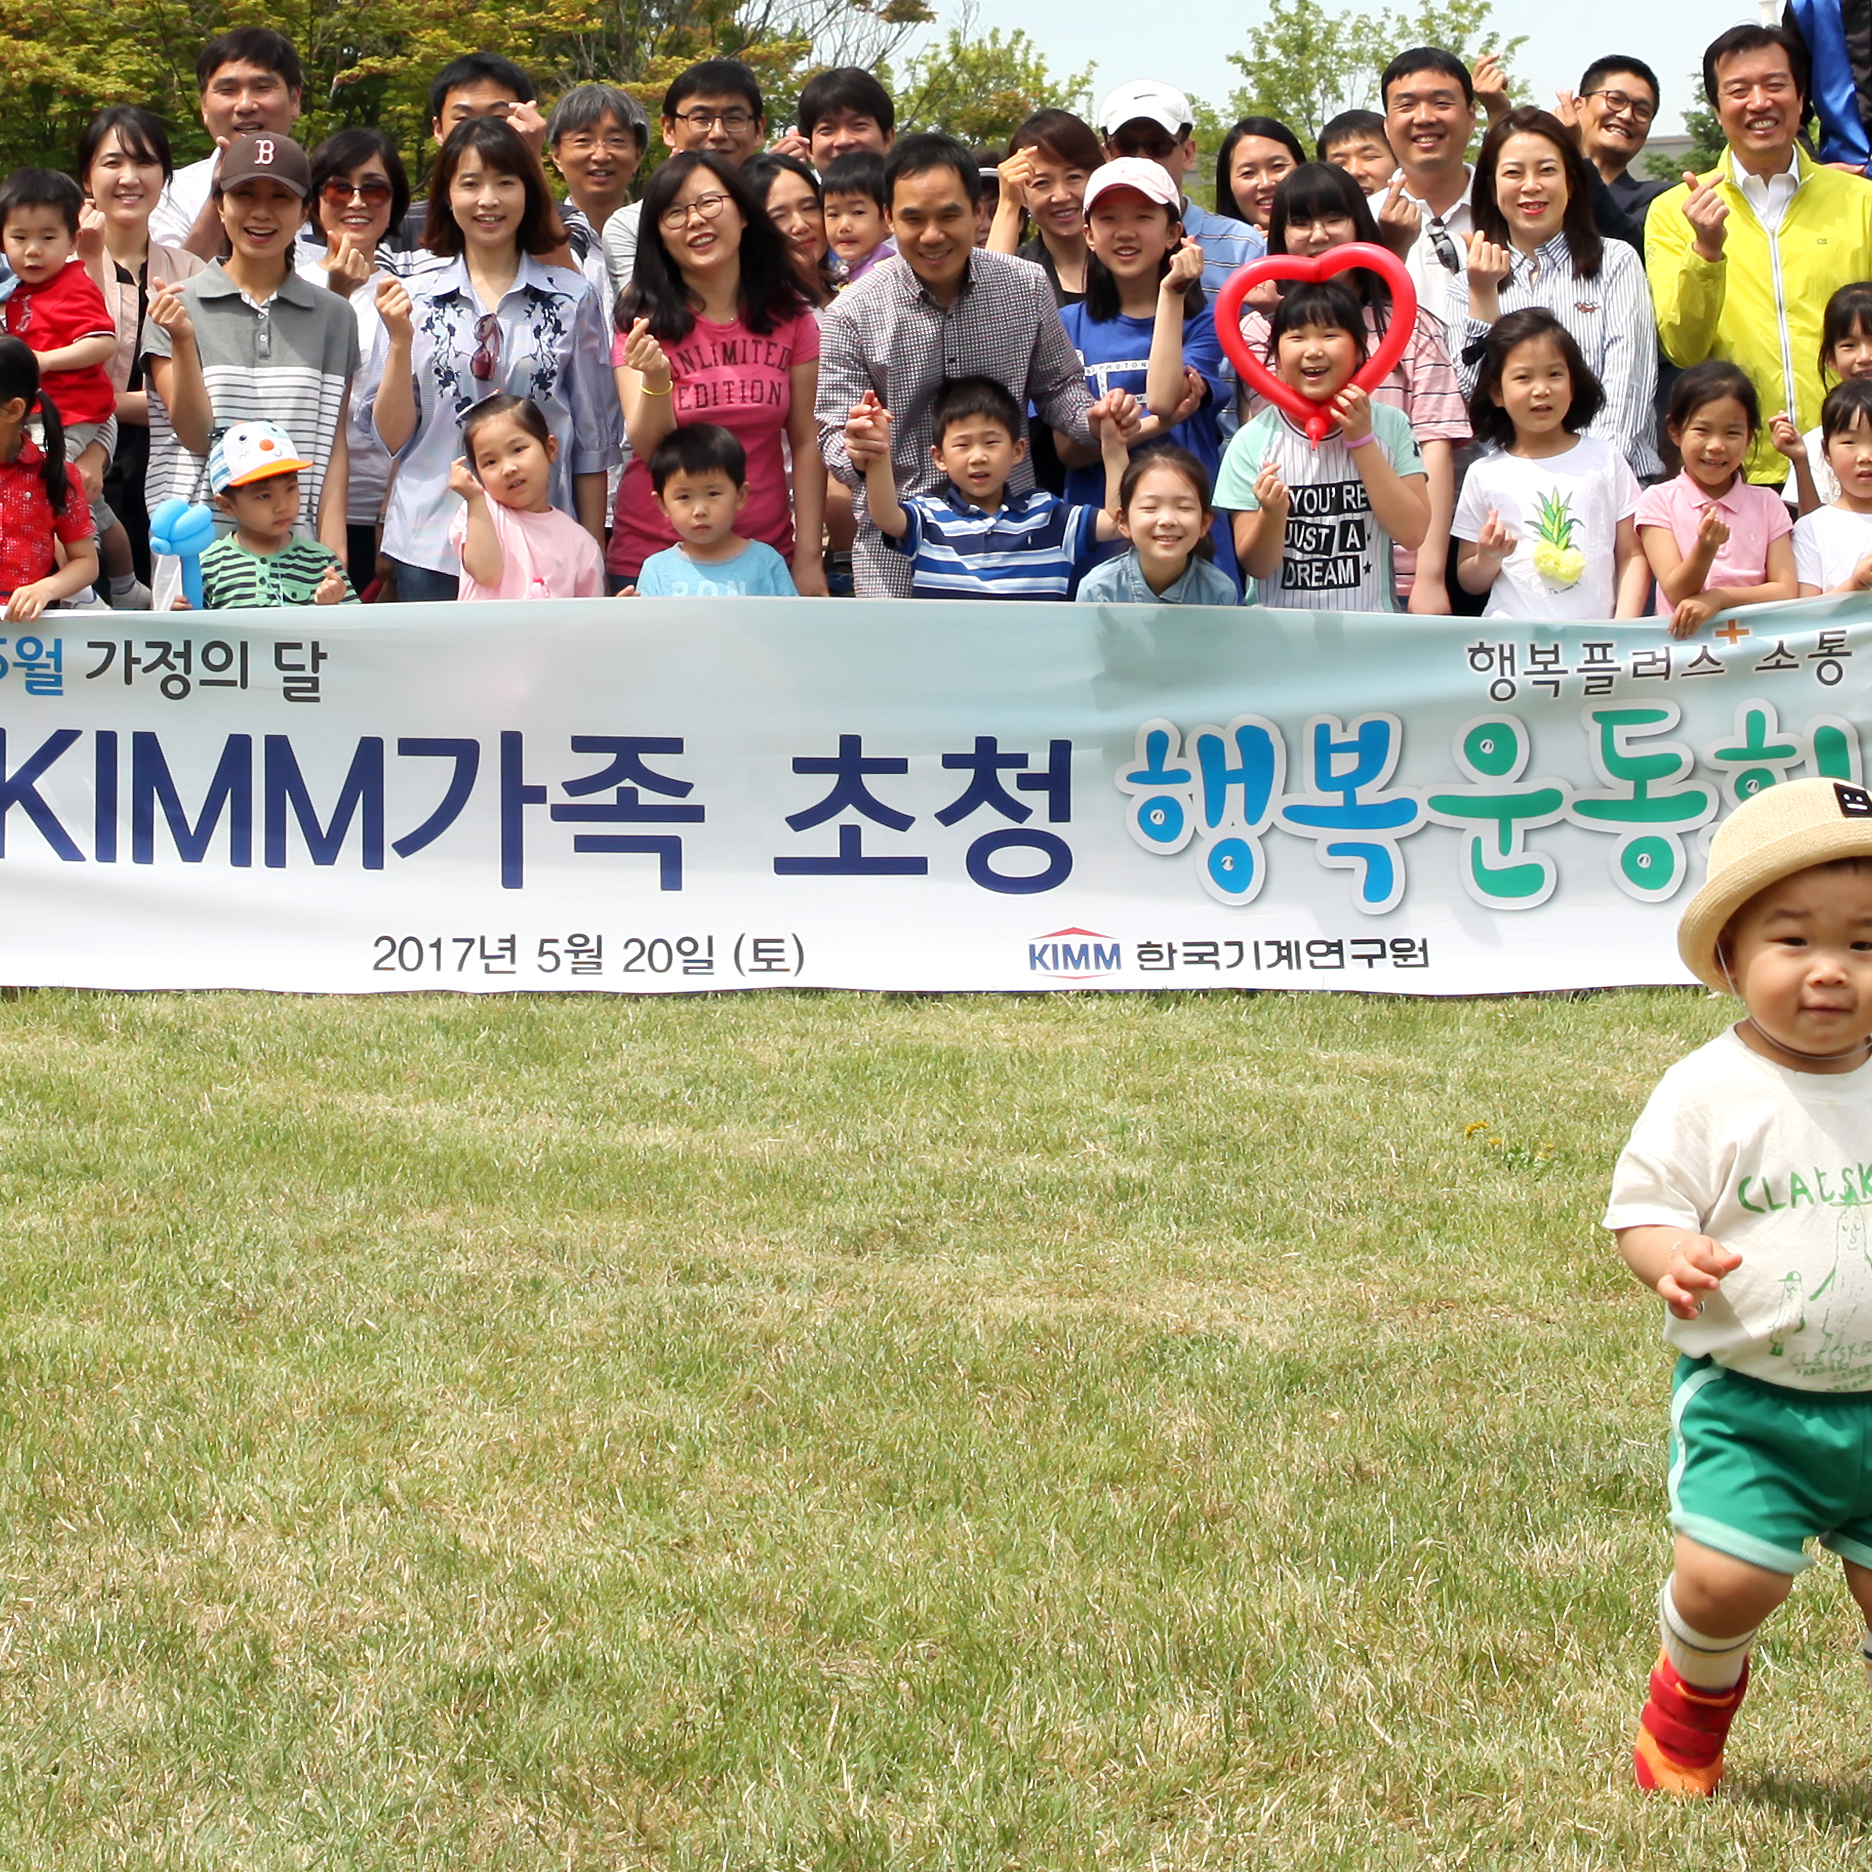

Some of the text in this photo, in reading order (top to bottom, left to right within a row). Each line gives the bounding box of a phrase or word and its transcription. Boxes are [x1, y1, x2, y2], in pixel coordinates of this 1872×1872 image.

[254, 138, 276, 166] B
[677, 379, 783, 411] EDITION
[1284, 522, 1361, 552] JUST A
[1284, 558, 1355, 588] DREAM
[85, 639, 249, 701] 가정의
[274, 640, 329, 703] 달
[1467, 630, 1853, 702] 행복플러스 소통
[773, 734, 1073, 895] 초청
[373, 933, 805, 975] 2017년 5월 20일 (토)
[1028, 938, 1429, 971] KIMM 한국기계연구원
